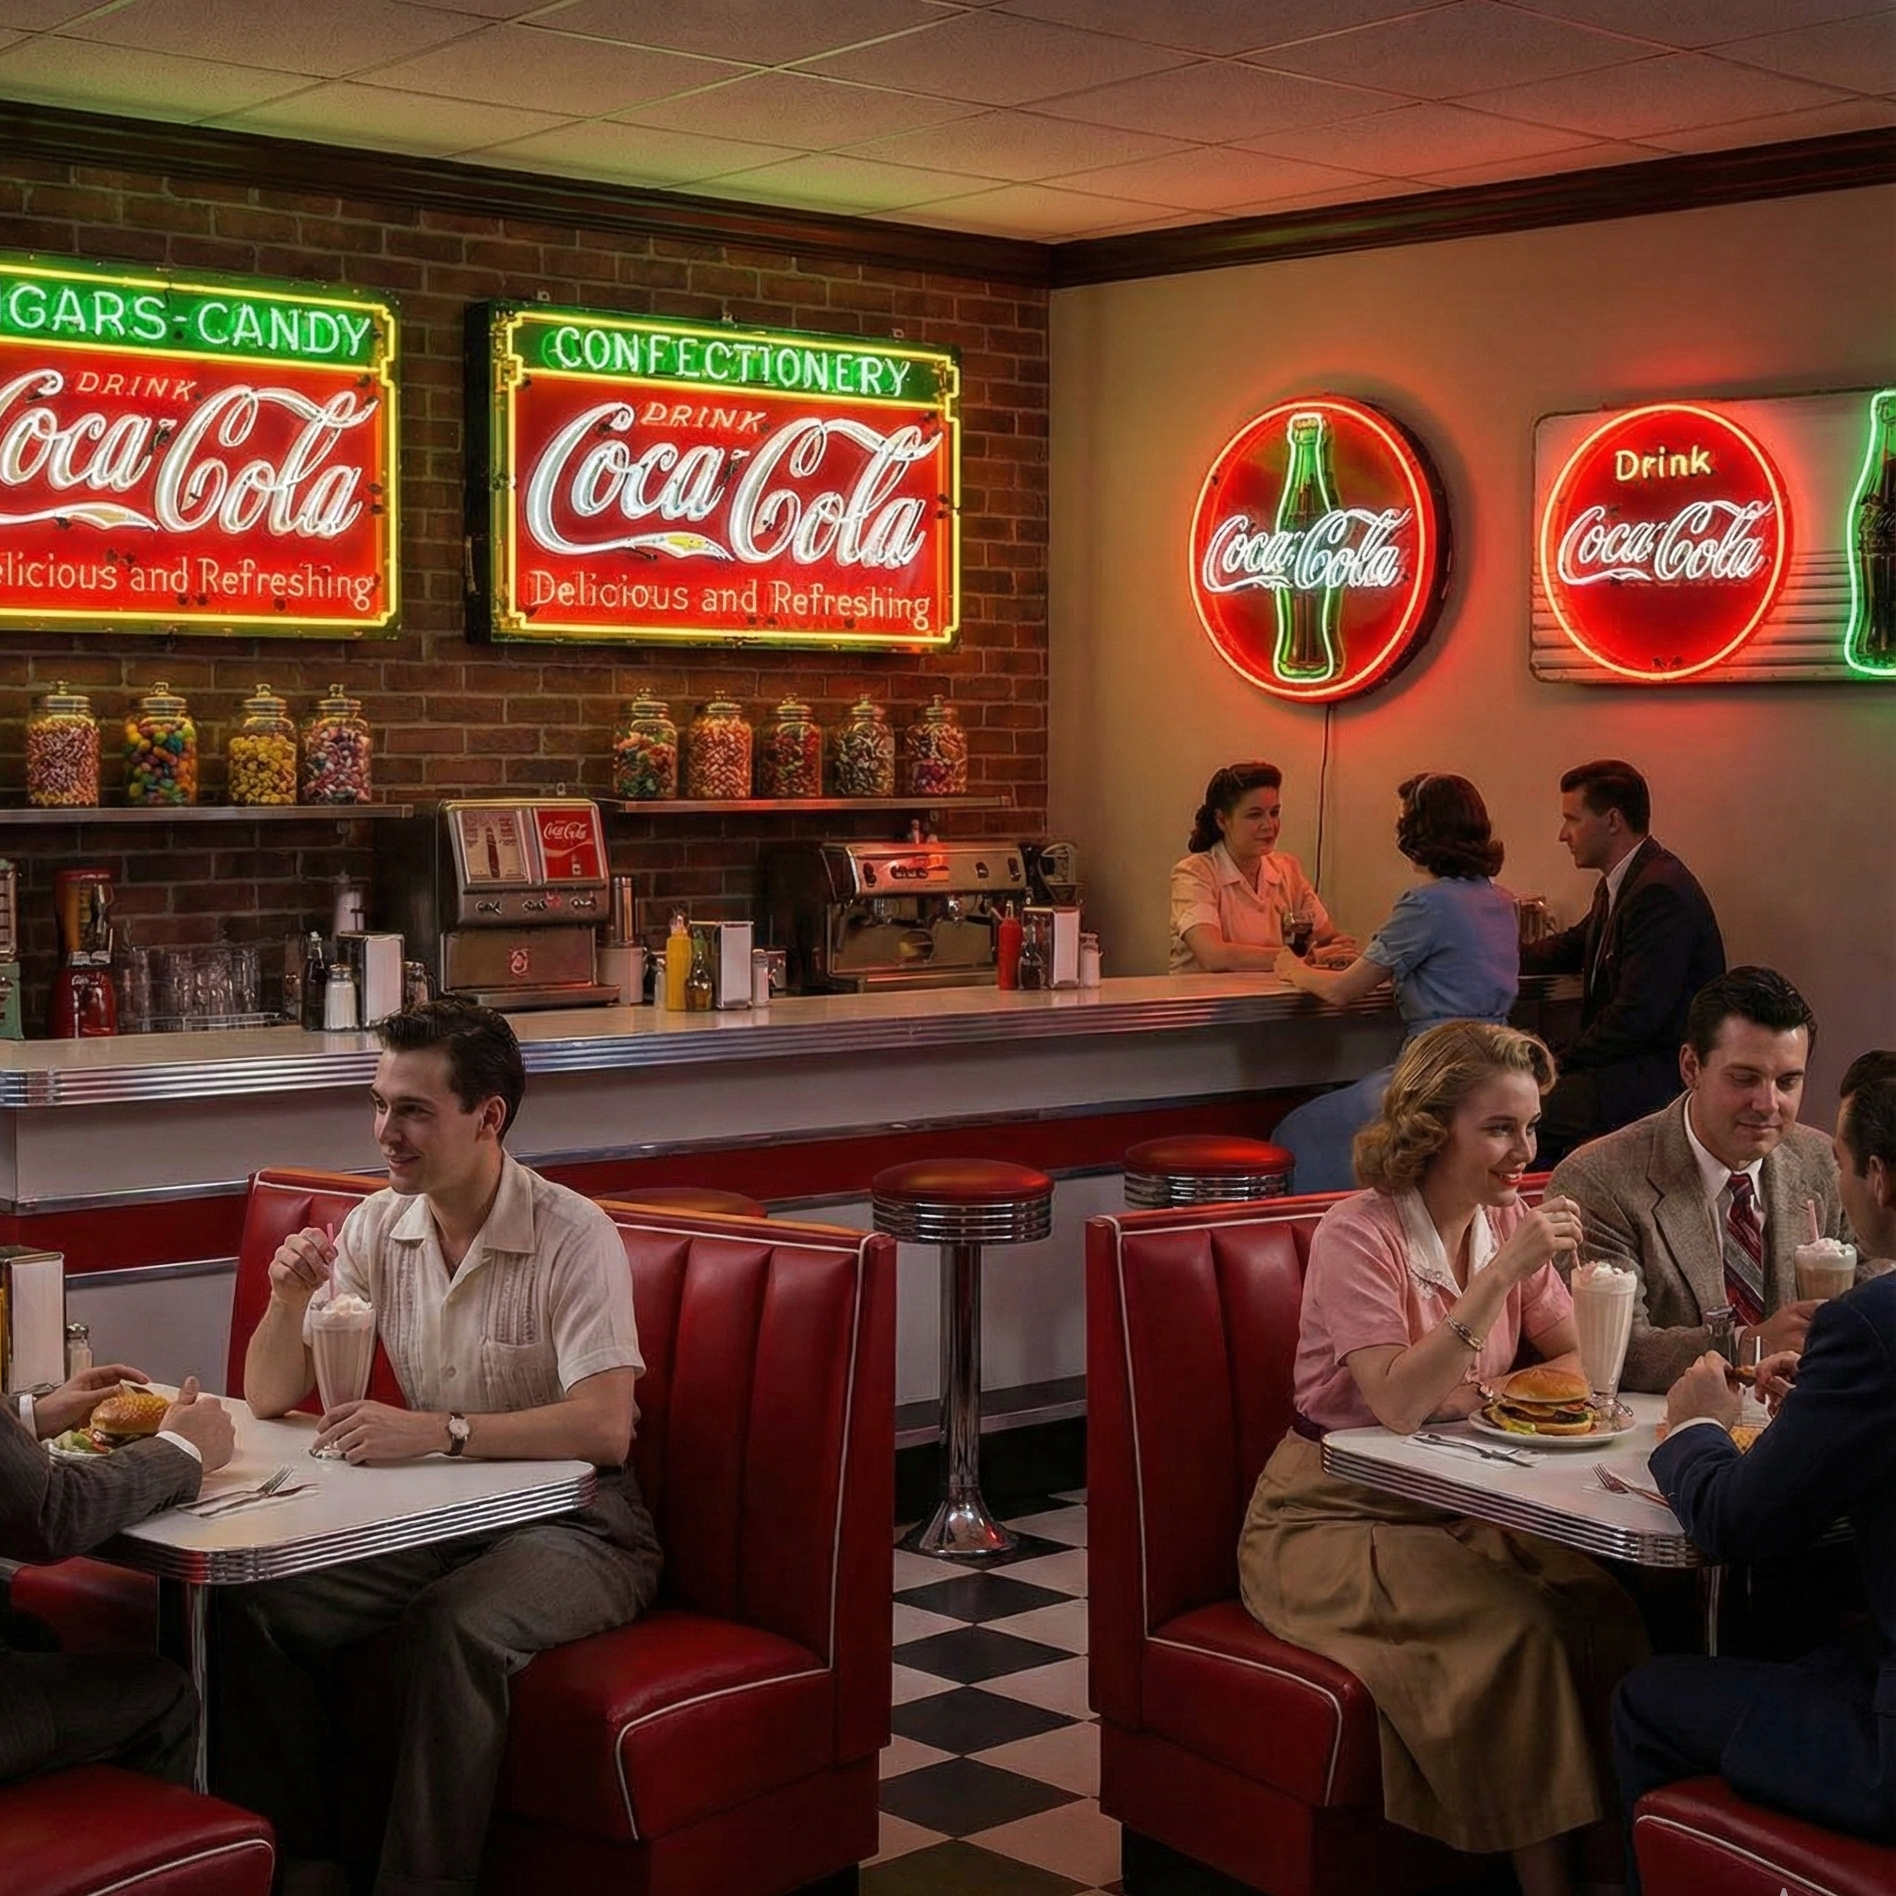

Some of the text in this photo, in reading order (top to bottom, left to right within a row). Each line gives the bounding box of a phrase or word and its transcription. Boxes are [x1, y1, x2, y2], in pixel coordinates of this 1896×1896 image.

[77, 371, 197, 401] DRINK
[555, 326, 911, 397] CONFECTIONERY
[641, 401, 767, 433] DRINK
[526, 401, 943, 568] Coca-Cola
[1615, 445, 1712, 482] Drink
[1202, 507, 1411, 593] Coca-Cola
[1557, 500, 1773, 585] Coca-Cola
[0, 551, 375, 612] licious and Refreshing
[530, 570, 931, 631] Delicious and Refreshing
